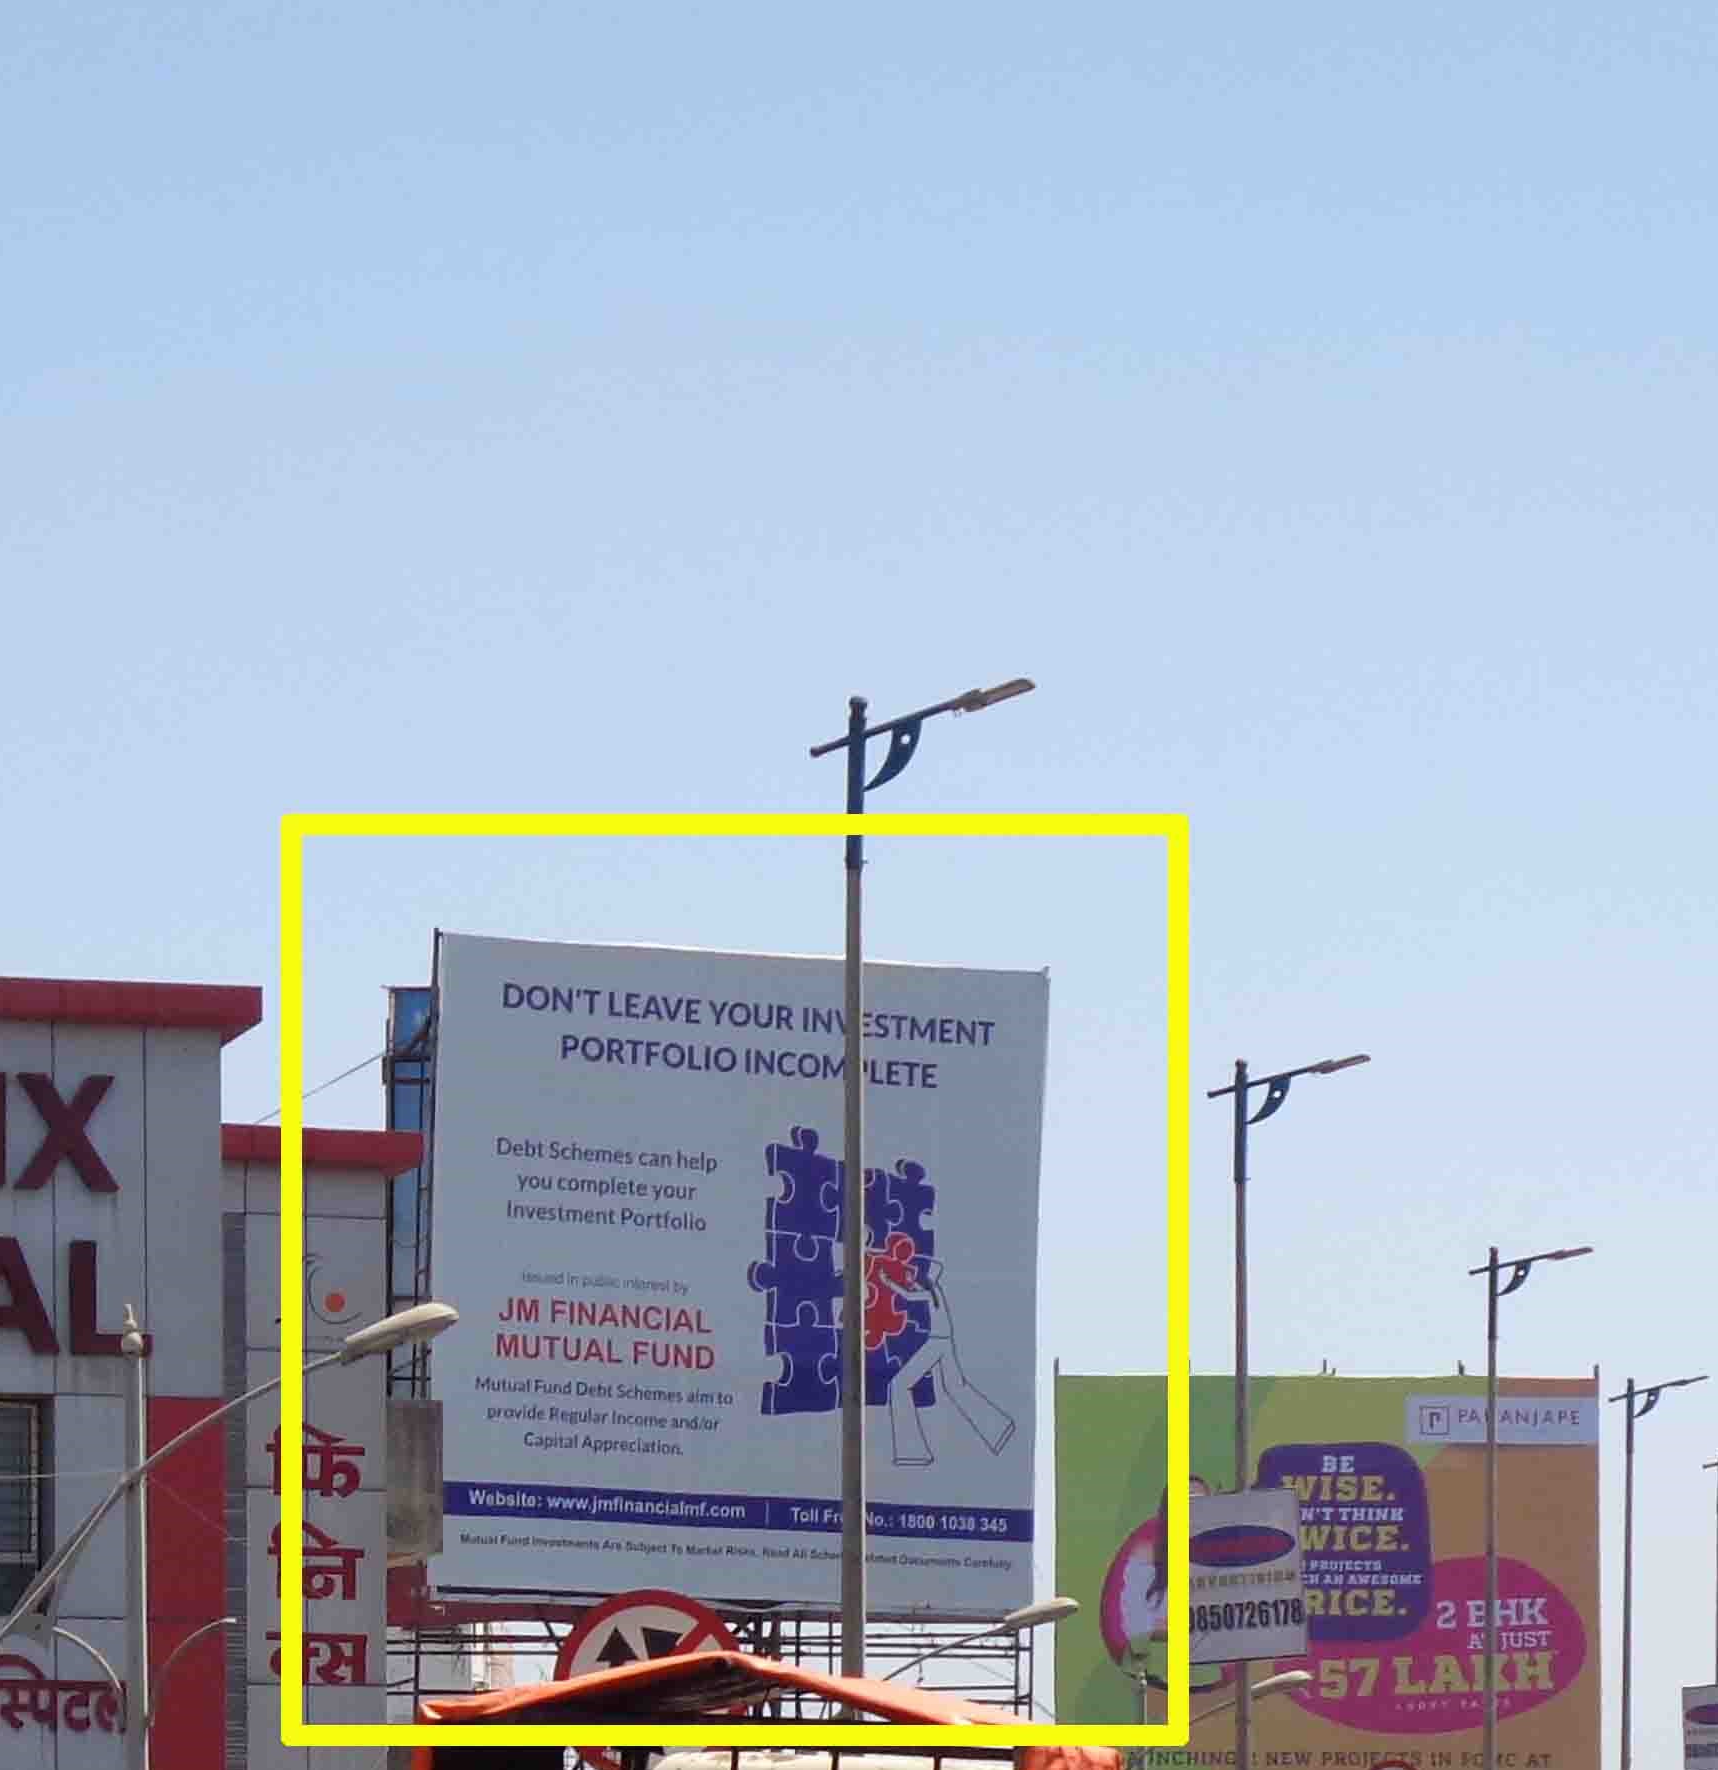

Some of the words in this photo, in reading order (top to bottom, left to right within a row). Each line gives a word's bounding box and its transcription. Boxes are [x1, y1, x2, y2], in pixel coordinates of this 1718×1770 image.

[502, 983, 601, 1015] DON'T
[608, 991, 701, 1024] LEAVE
[709, 1001, 794, 1031] YOUR
[561, 1034, 738, 1072] PORTFOLIO
[744, 1047, 939, 1089] INCOMLETE
[495, 1137, 545, 1159] Debt
[549, 1141, 634, 1165] Schemes
[638, 1151, 672, 1169] can
[676, 1150, 718, 1174] help
[517, 1174, 552, 1191] you
[557, 1176, 648, 1197] complete
[652, 1185, 697, 1201] your
[507, 1200, 616, 1225] Investment
[621, 1207, 707, 1232] Portfolio
[498, 1297, 540, 1323] JM
[550, 1299, 713, 1334] FINANCIAL
[495, 1333, 623, 1364] MUTUAL
[633, 1341, 716, 1370] FUND
[474, 1375, 531, 1393] Mutual
[535, 1379, 572, 1396] Fund
[576, 1381, 613, 1398] Debt
[617, 1384, 683, 1404] Schemes
[687, 1390, 714, 1405] aim
[717, 1392, 734, 1406] to
[486, 1405, 546, 1425] provide
[549, 1408, 609, 1426] Regular
[612, 1411, 669, 1428] Income
[671, 1414, 720, 1432] and/or
[1458, 1407, 1581, 1427] PAANJAPE
[523, 1432, 578, 1451] Capital
[1321, 1455, 1355, 1473] BE
[468, 1488, 543, 1508] Website:
[546, 1494, 746, 1519] www.jmfinancialmf.com
[790, 1507, 819, 1524] Toll
[899, 1512, 936, 1530] 1800
[979, 1516, 1008, 1533] 345
[1338, 1507, 1405, 1522] THINK
[1299, 1525, 1410, 1551] WICE.
[1347, 1573, 1423, 1586] AWESOME
[1305, 1589, 1408, 1617] RICE.
[1436, 1600, 1457, 1629] 2
[1498, 1630, 1553, 1650] JUST
[1391, 1650, 1556, 1695] LAKH
[1266, 1750, 1312, 1768] NEW
[1426, 1751, 1452, 1766] IN
[1525, 1753, 1553, 1768] AT
